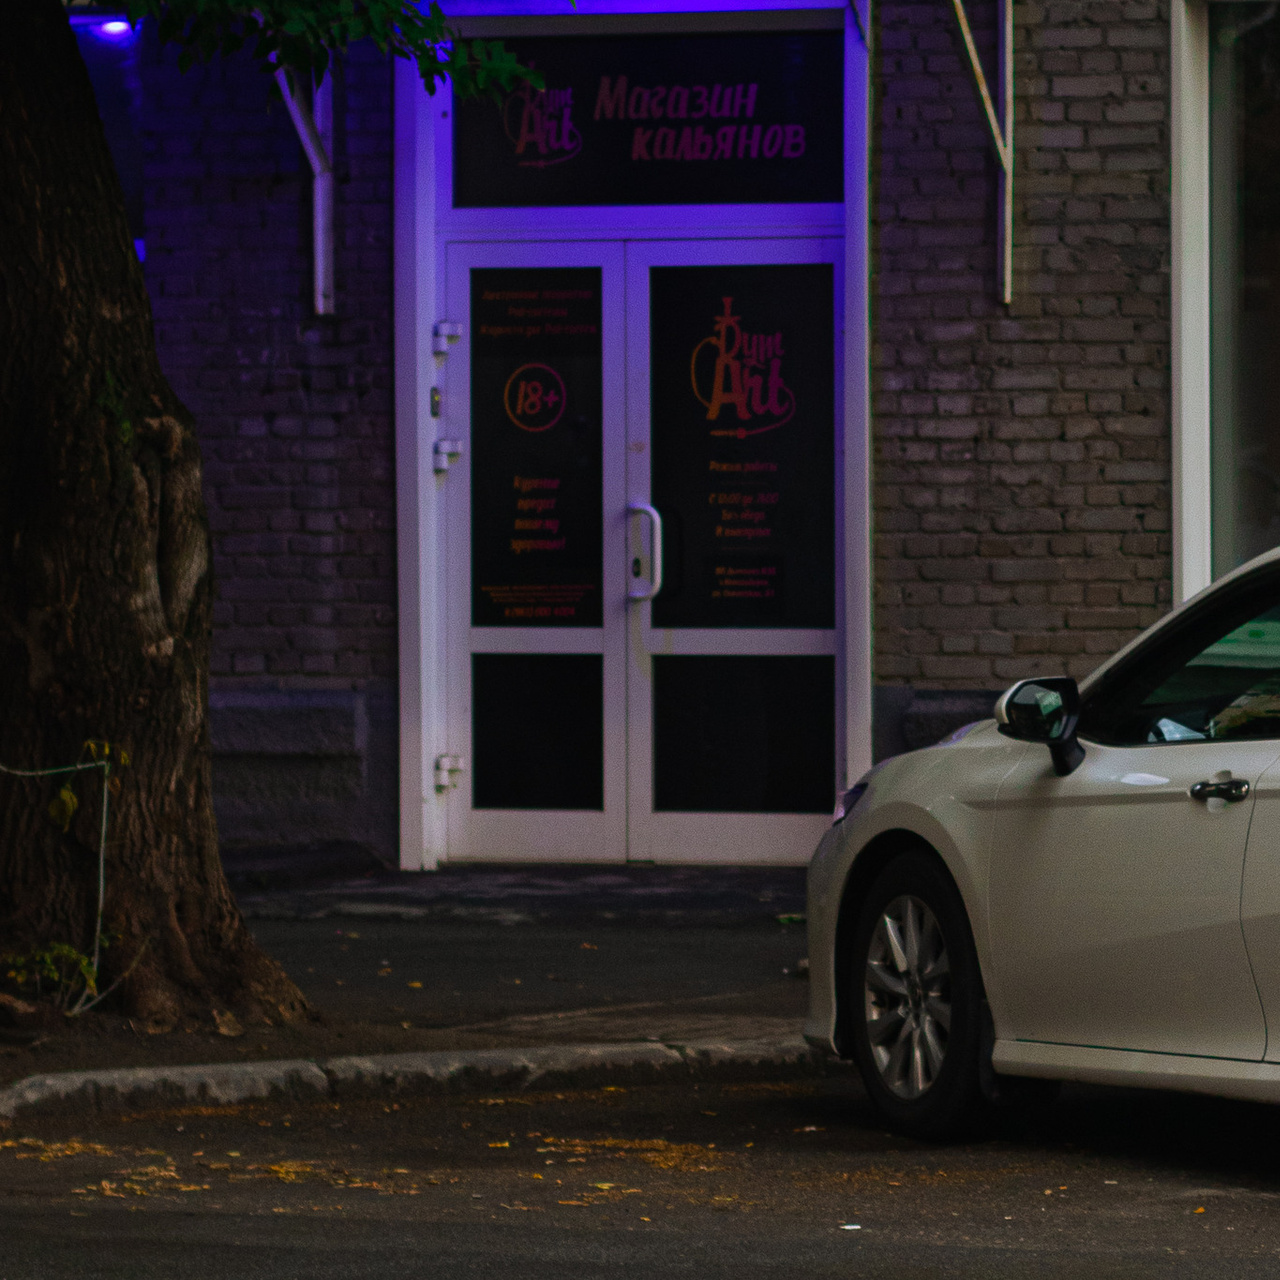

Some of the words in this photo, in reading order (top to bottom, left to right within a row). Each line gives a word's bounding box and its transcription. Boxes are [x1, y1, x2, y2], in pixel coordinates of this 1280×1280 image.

[594, 75, 760, 121] Магазин
[631, 124, 807, 162] кальянов
[515, 380, 561, 416] 18+
